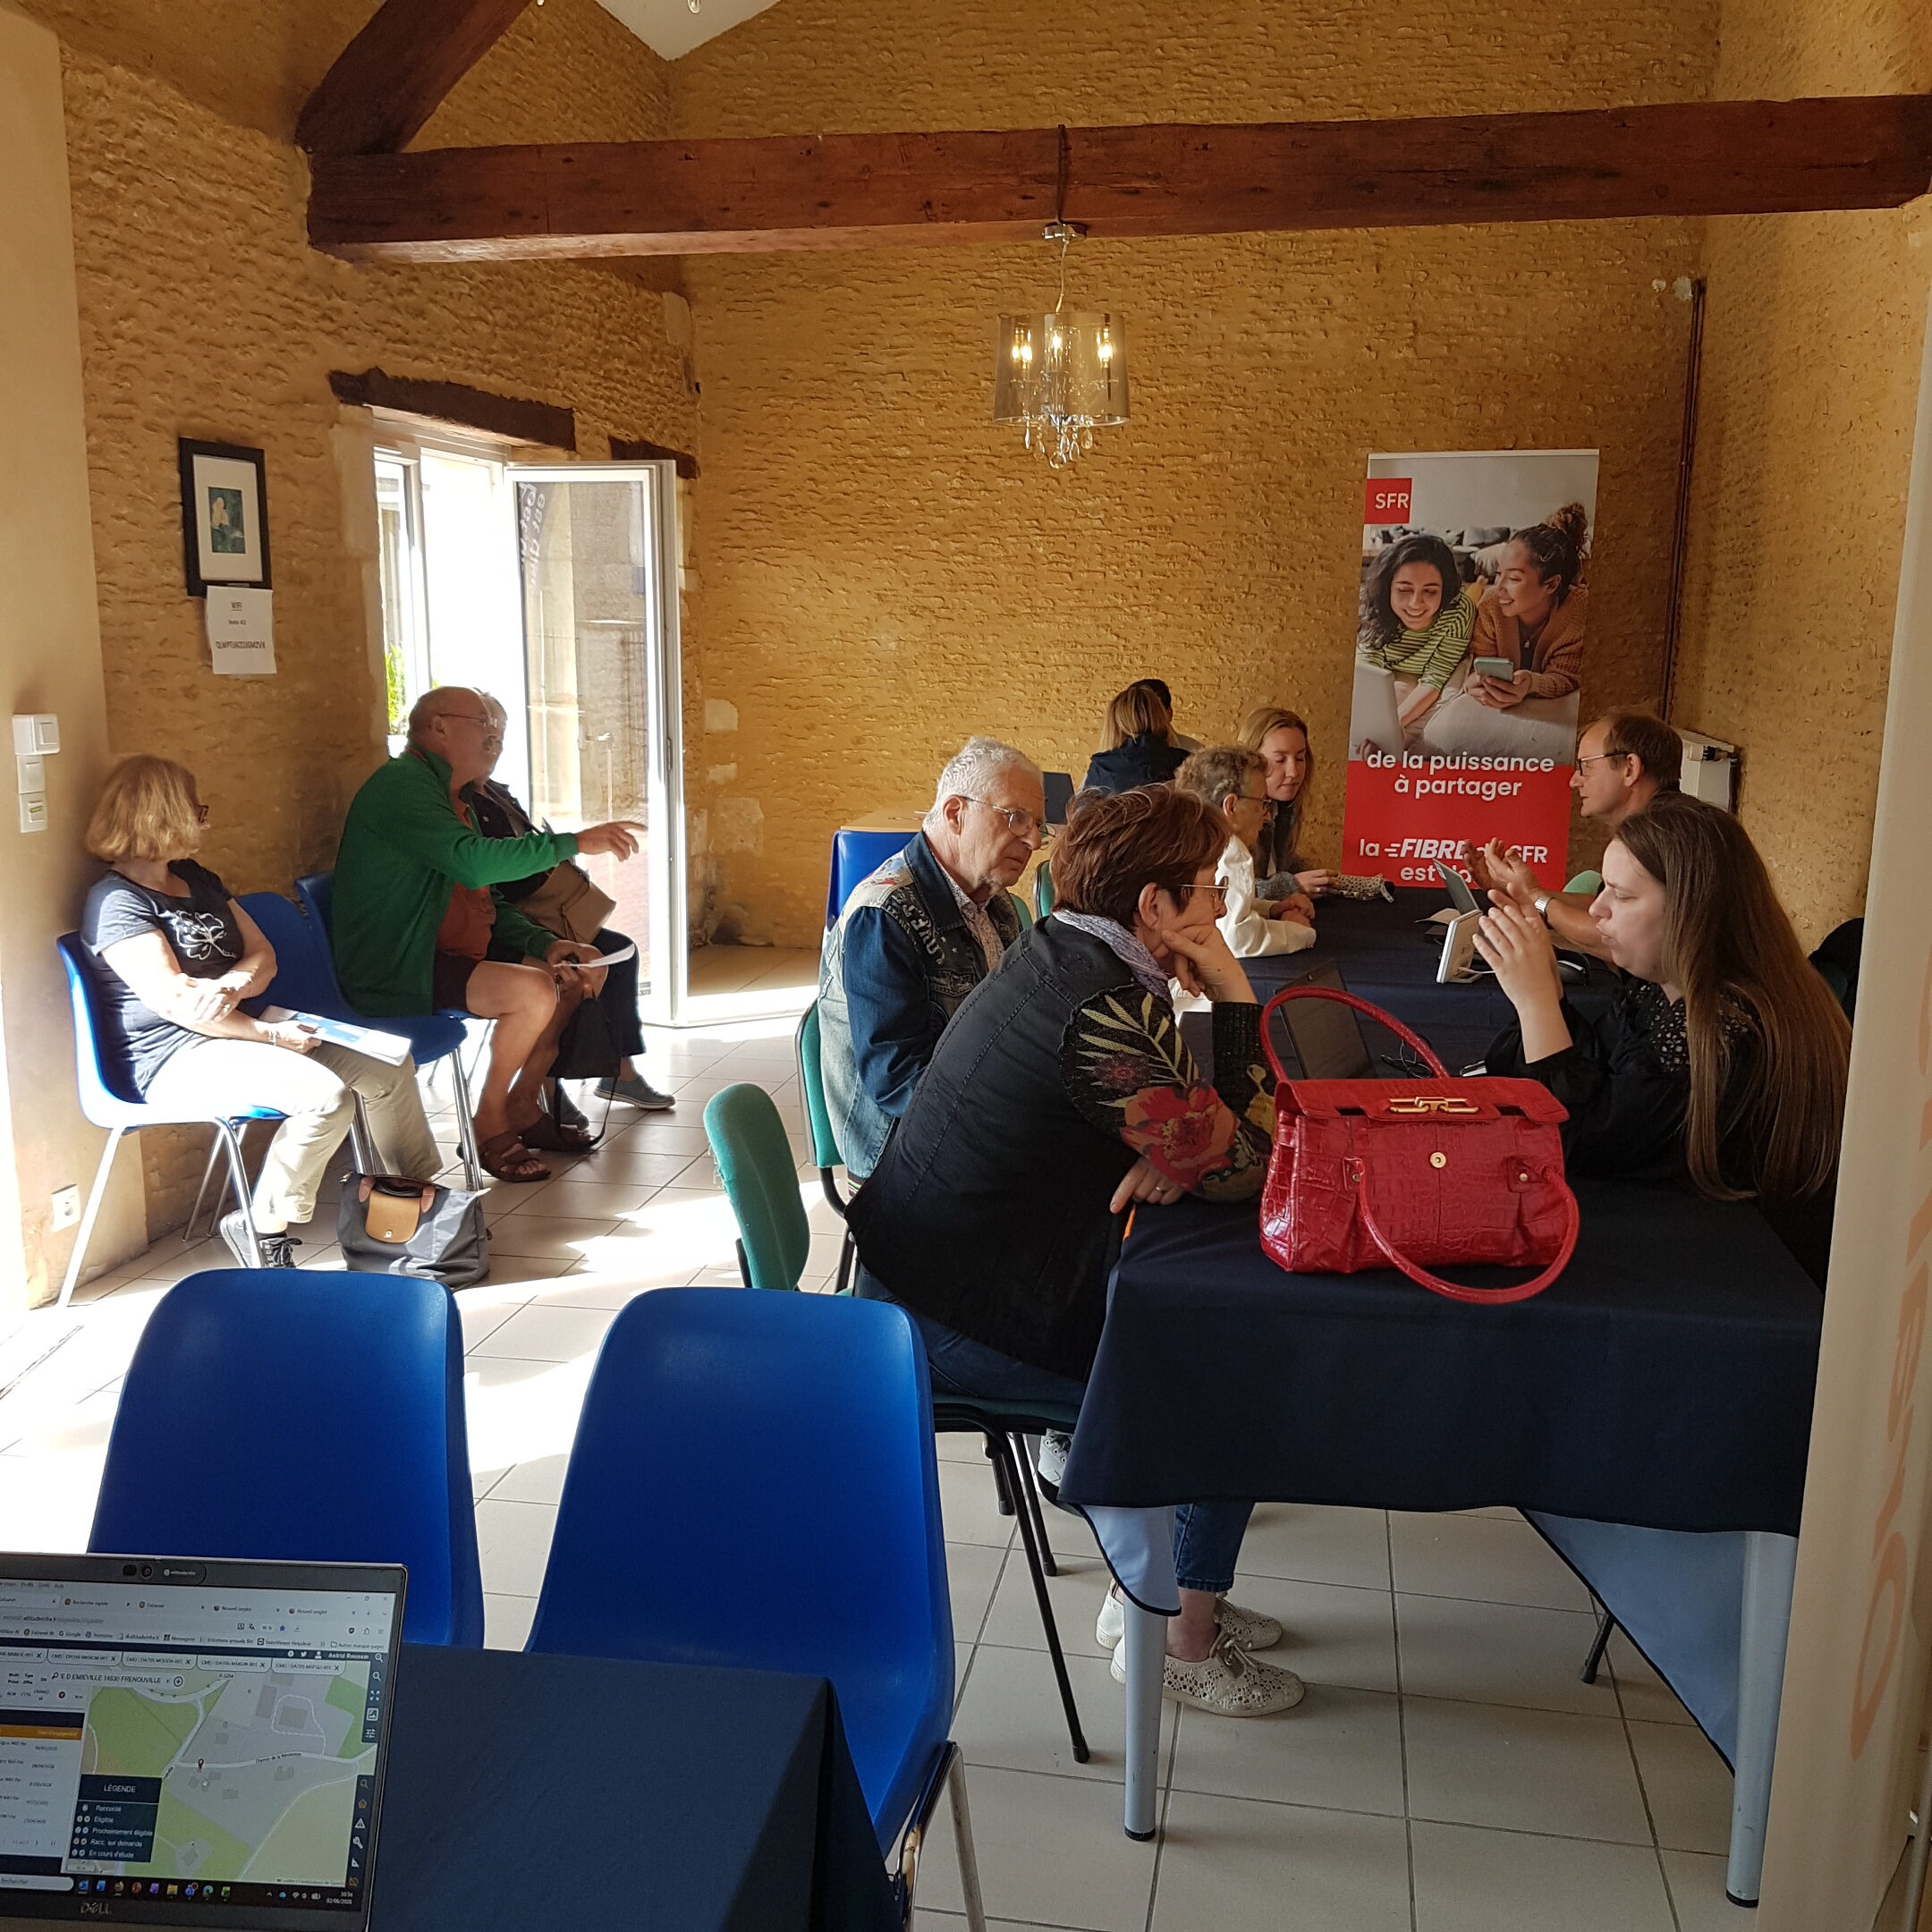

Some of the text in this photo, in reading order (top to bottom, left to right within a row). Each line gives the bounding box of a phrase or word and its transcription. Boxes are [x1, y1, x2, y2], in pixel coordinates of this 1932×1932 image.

[1375, 493, 1409, 509] SFR
[1367, 750, 1555, 775] de la puissance
[1394, 774, 1522, 801] à partager
[1359, 839, 1379, 858] la
[1400, 864, 1436, 882] est
[121, 1675, 161, 1683] FRENOUVILLE
[103, 1784, 136, 1793] LÉGENDE
[80, 1902, 113, 1916] DELL
